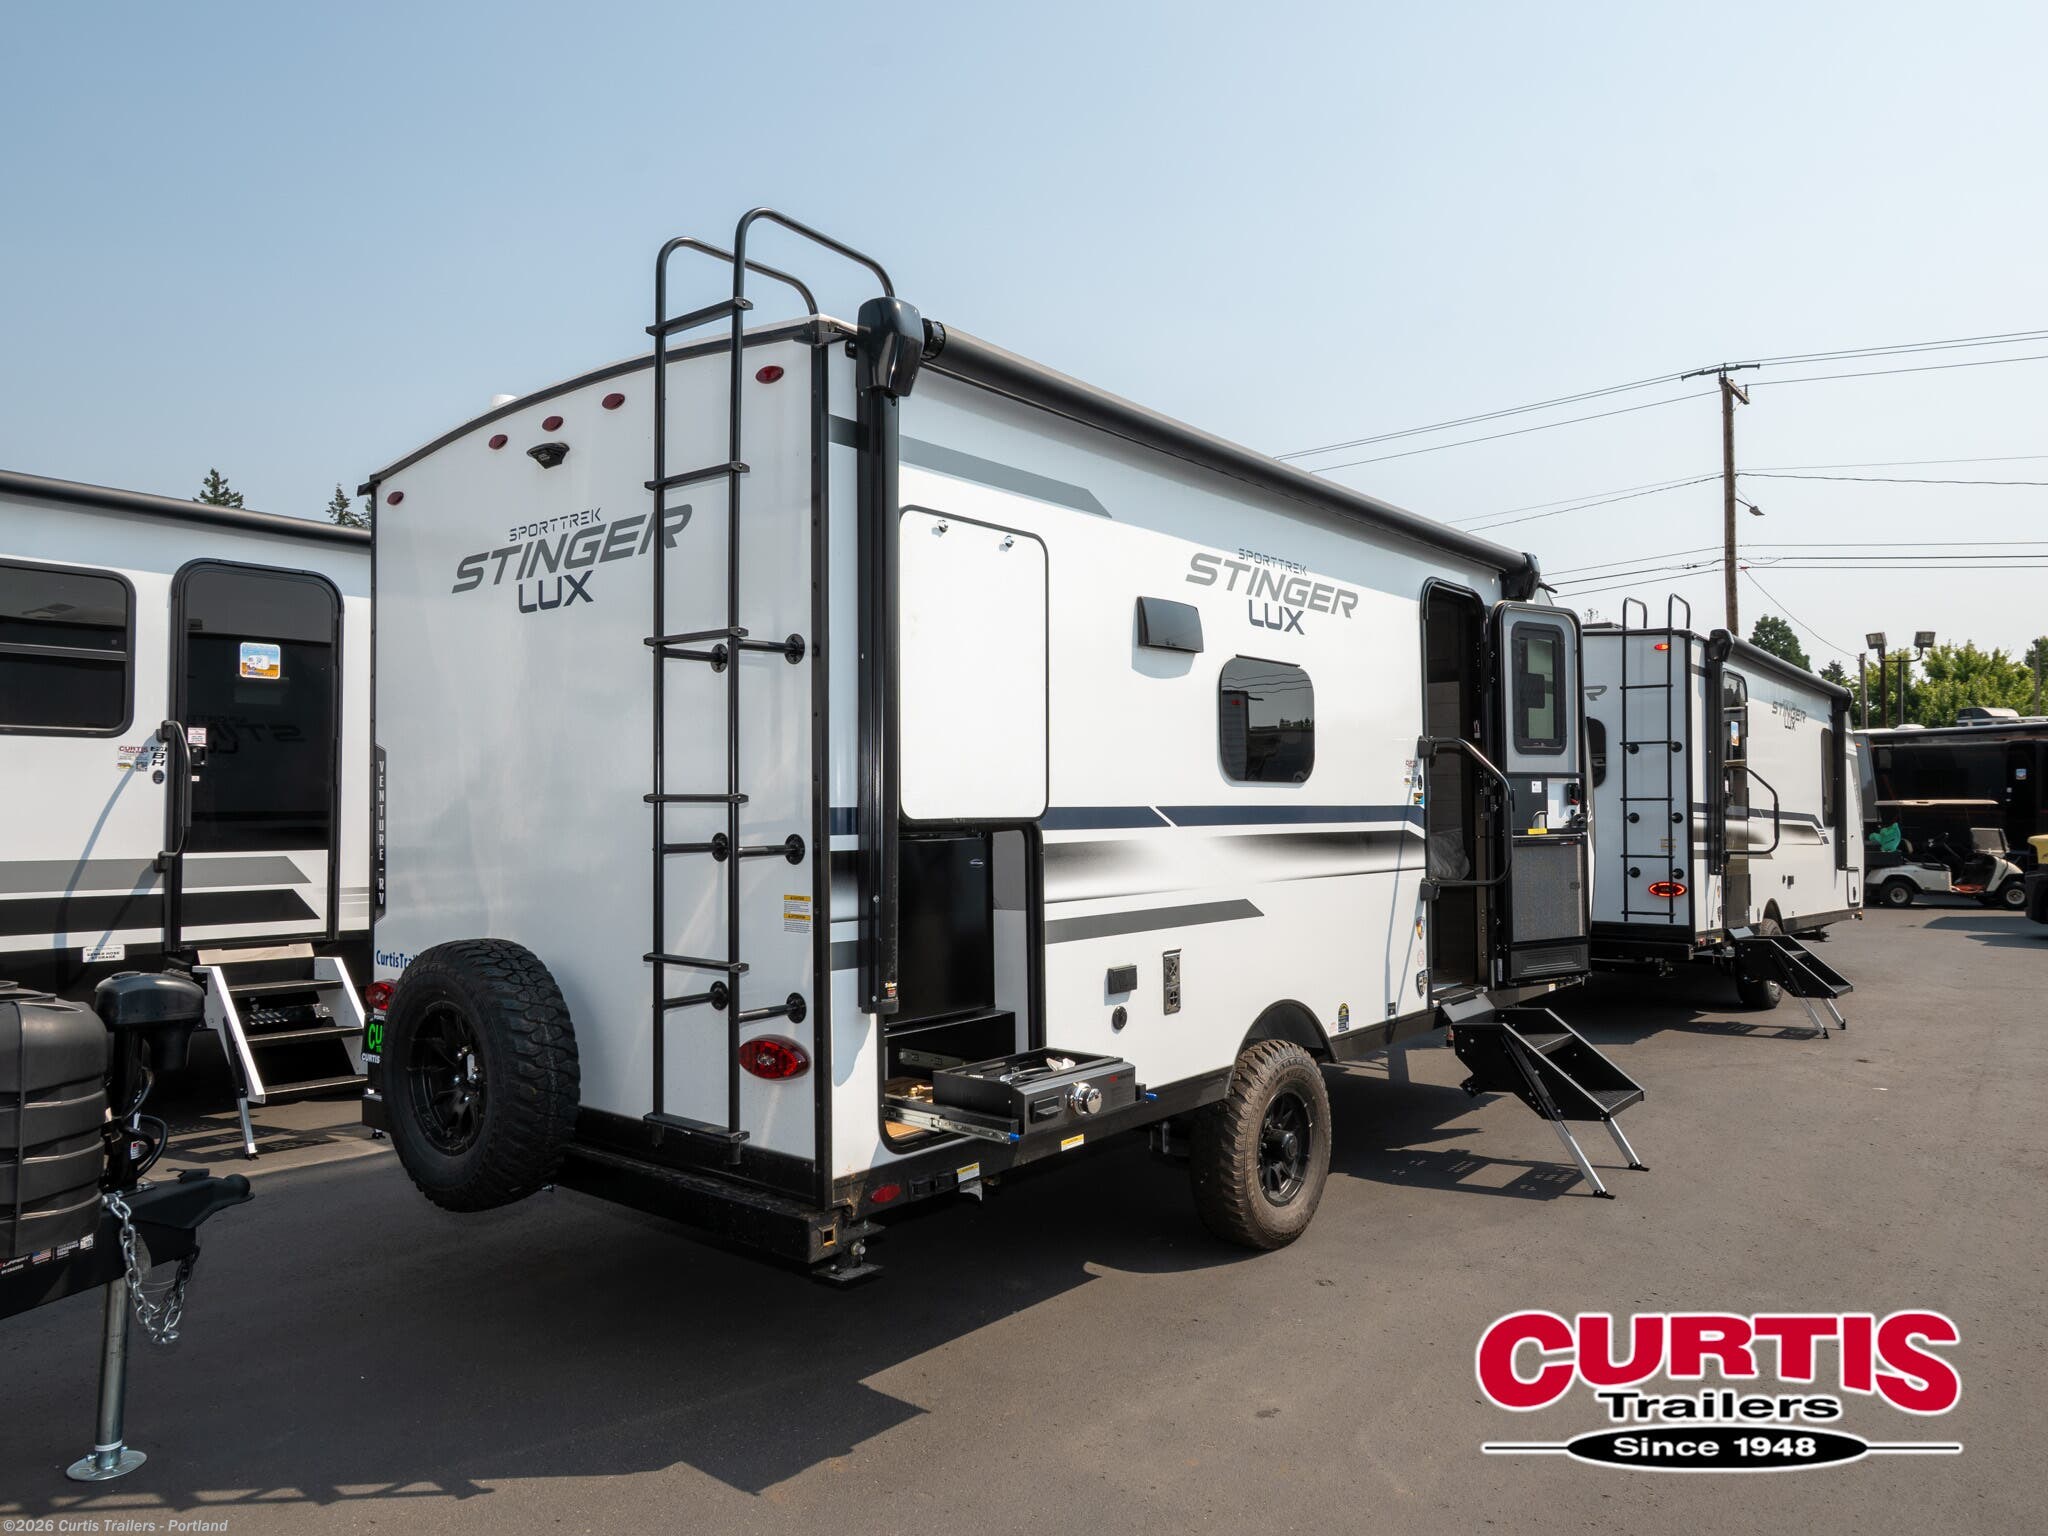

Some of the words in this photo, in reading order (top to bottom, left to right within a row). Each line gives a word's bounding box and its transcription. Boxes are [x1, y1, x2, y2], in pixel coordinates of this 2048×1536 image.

[509, 507, 601, 542] SPORTTREK
[451, 504, 693, 594] STINGER
[1238, 548, 1307, 576] SPORTTREK
[518, 570, 594, 614] LUX
[1185, 552, 1359, 618] STINGER
[1248, 599, 1305, 635] LUX
